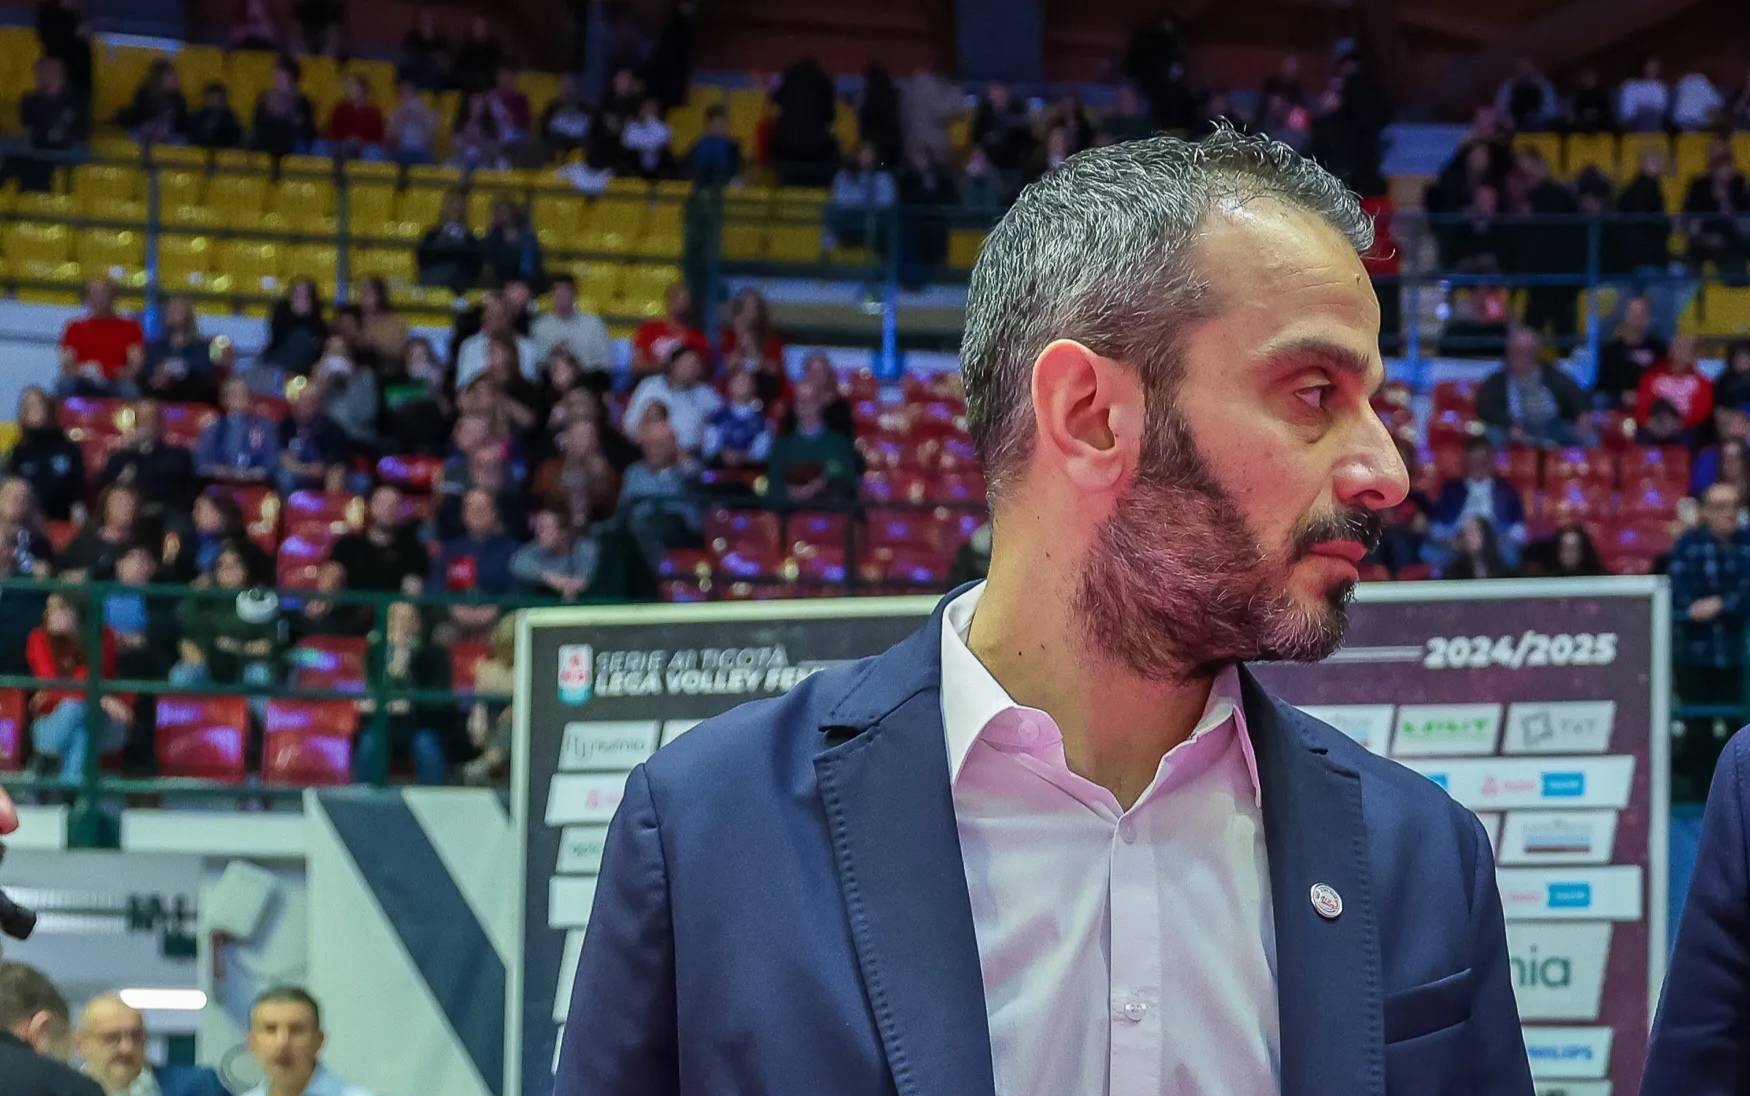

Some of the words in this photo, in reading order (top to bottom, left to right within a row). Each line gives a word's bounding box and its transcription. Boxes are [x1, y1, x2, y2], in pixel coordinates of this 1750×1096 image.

[1424, 630, 1617, 669] 2024/2025
[594, 671, 663, 697] LEGA
[665, 668, 764, 695] VOLLEY
